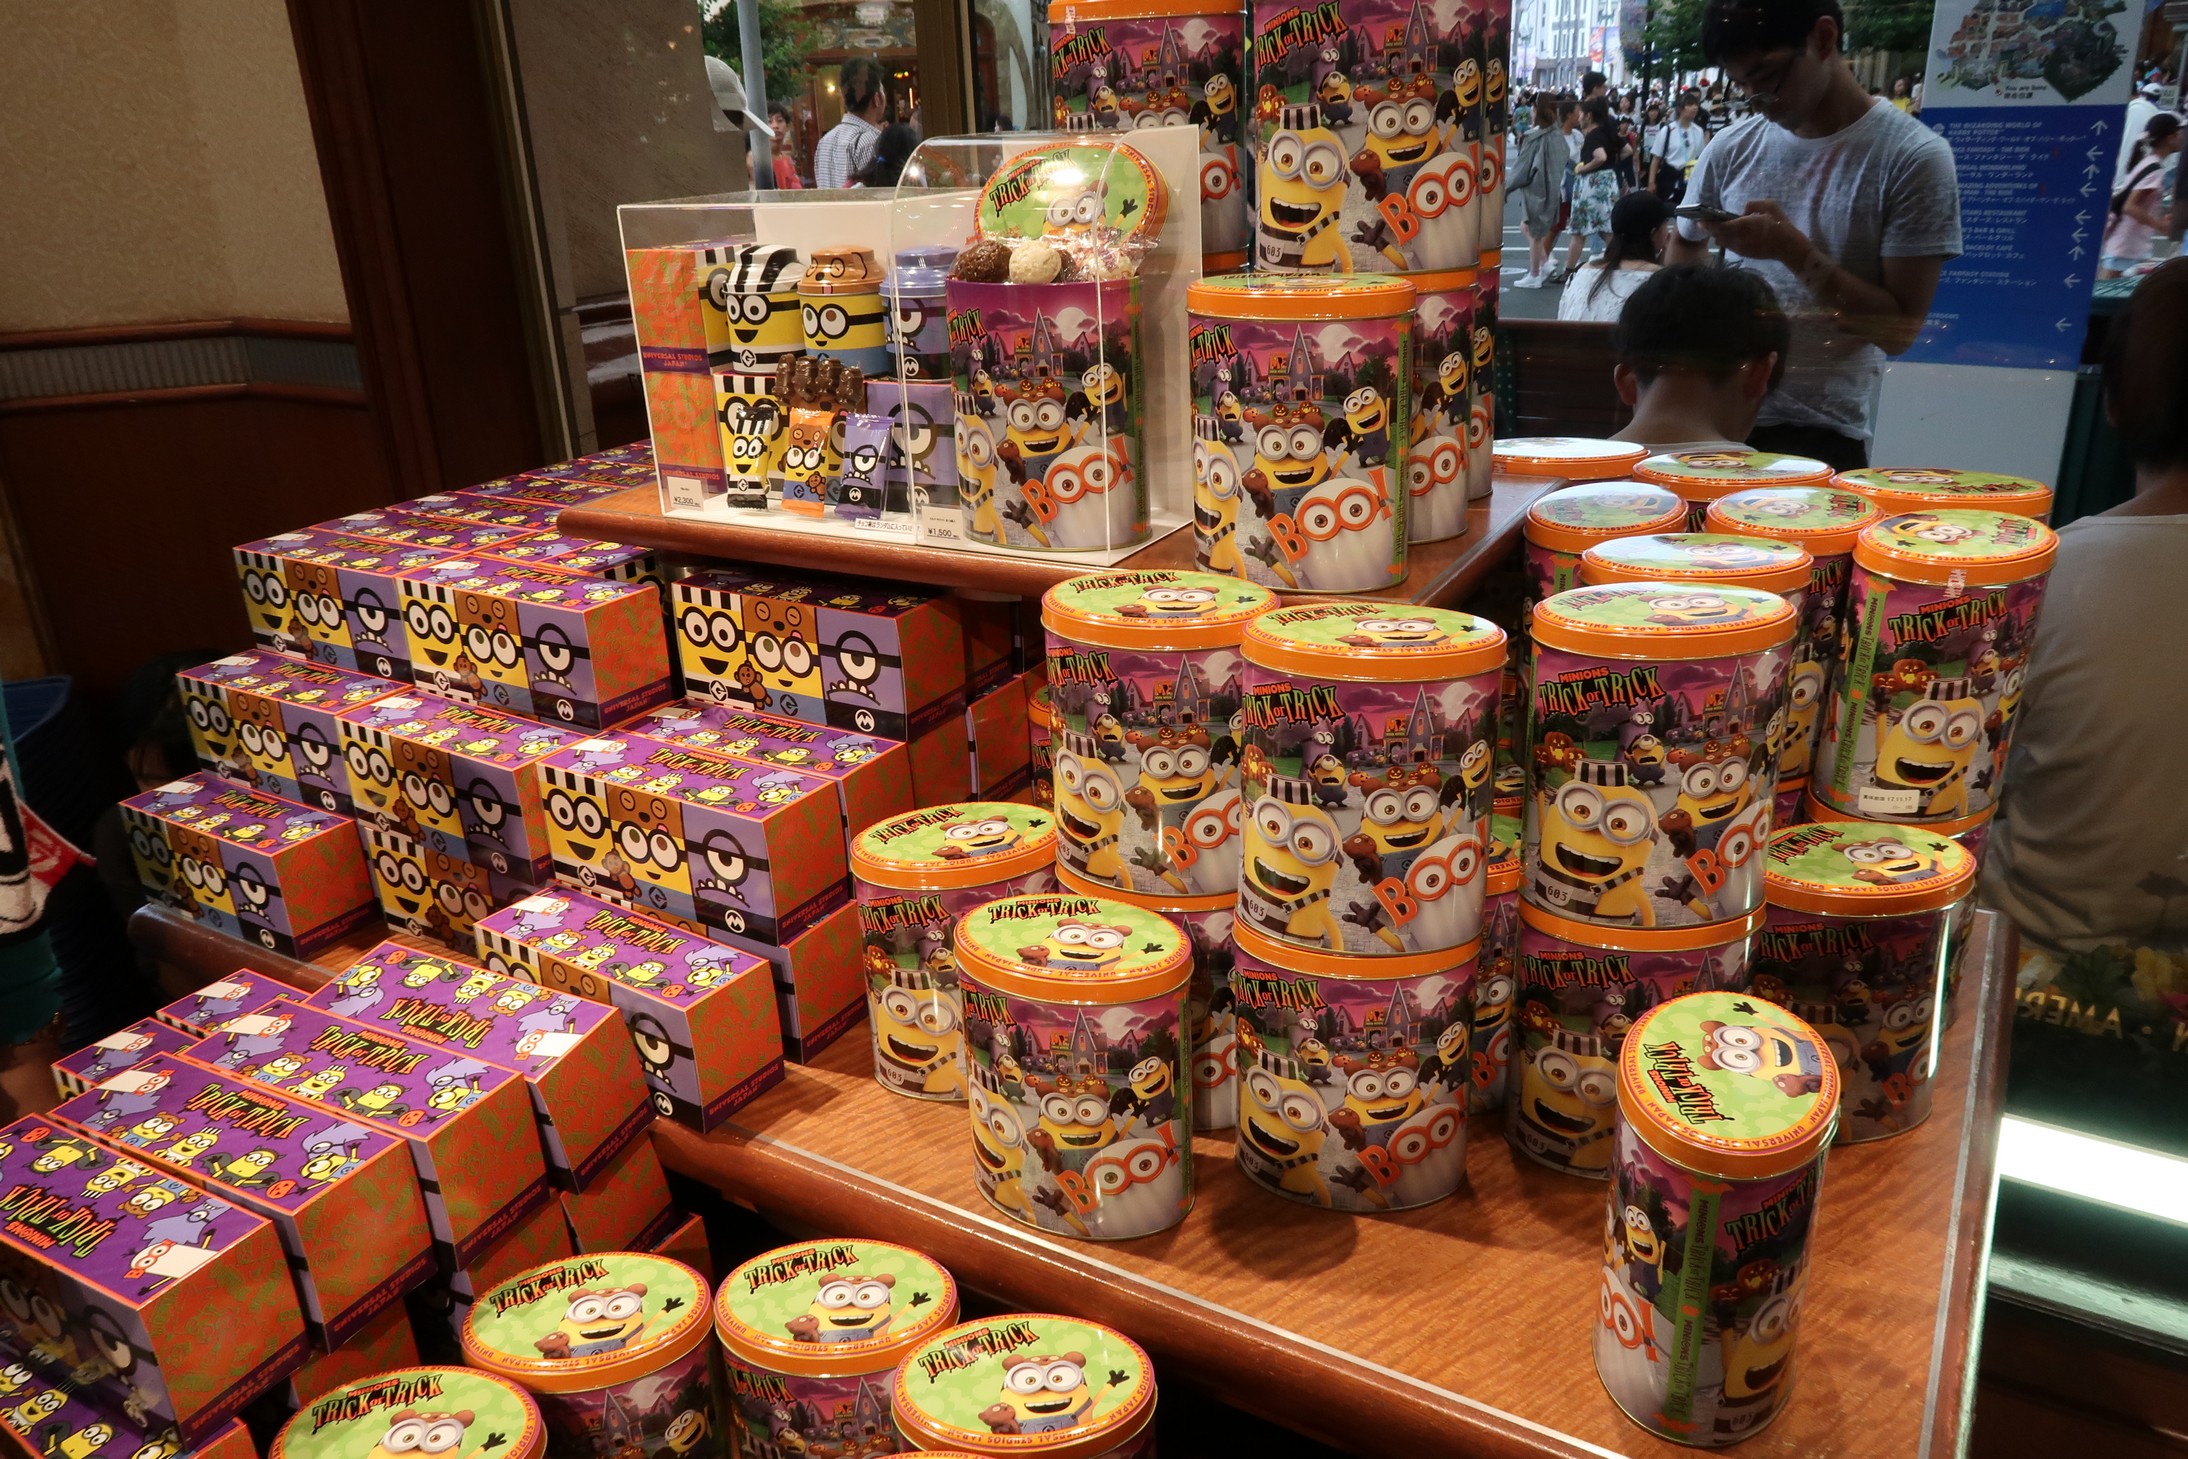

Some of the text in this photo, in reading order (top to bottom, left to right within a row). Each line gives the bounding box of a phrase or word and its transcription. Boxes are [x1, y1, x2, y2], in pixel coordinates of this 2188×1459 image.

[1264, 7, 1300, 30] MINIONS
[1284, 1, 1348, 46] or TRICK
[1069, 27, 1113, 67] TRICK
[990, 173, 1030, 213] TRICK
[1265, 243, 1282, 259] 603
[954, 308, 987, 345] TRICK
[1198, 324, 1238, 362] TRICK
[643, 352, 703, 361] UNIVERSAL STUDIOS
[928, 528, 951, 537] ¥1,500
[1070, 572, 1181, 593] TRICK TRICK
[1270, 605, 1385, 626] TRICK TRICK
[1865, 597, 1878, 636] MINIONS
[1887, 590, 2010, 645] TRICK or TRICK
[1919, 596, 1972, 614] MINIONS
[1062, 653, 1118, 689] or TRICK
[1559, 667, 1610, 682] MINIONS
[603, 694, 640, 714] UNIVERSAL
[1253, 682, 1291, 696] MINIONS
[1274, 685, 1345, 726] or TRICK
[1538, 666, 1666, 717] TRICK or TRICK
[725, 714, 824, 743] TRICK TRICK
[761, 717, 803, 729] MINIONS
[648, 747, 750, 781] TRICK TRICK
[688, 752, 732, 764] MINIONS
[870, 806, 965, 844] TRICK TRICK
[869, 896, 904, 907] MINIONS
[988, 899, 1101, 922] TRICK TRICK
[1248, 899, 1265, 919] 603
[1547, 884, 1568, 903] 603
[628, 916, 669, 932] MINIONS
[860, 894, 951, 933] TRICK or TRICK
[1774, 923, 1825, 933] MINIONS
[587, 909, 689, 955] TRICK TRICK
[1759, 923, 1876, 962] RICK or TRICK
[1522, 955, 1637, 991] TRICK or TRICK
[1539, 951, 1585, 961] MINIONS
[1243, 969, 1278, 982] MINIONS
[971, 992, 1016, 1028] TRICK
[1262, 978, 1326, 1012] or TRICK
[358, 1030, 407, 1050] MINIONS
[380, 998, 494, 1049] TRICK TRICK
[400, 1024, 448, 1045] MINIONS
[311, 1025, 431, 1075] TRICK TRICK
[1627, 1027, 1646, 1095] UNIVERSAL STUDIOS
[238, 1089, 288, 1111] MINIONS
[708, 1064, 780, 1116] UNIVERSAL STUDIOS
[1642, 1041, 1724, 1125] TRICK TRICK
[1647, 1069, 1677, 1104] MINIONS
[189, 1084, 309, 1139] TRICK TRICK
[1743, 1125, 1805, 1149] UNIVERSAL
[1, 1184, 118, 1259] TRICK TRICK
[5, 1220, 57, 1250] MINIONS
[461, 1184, 543, 1251] UNIVERSAL STUDIOS
[1726, 1199, 1789, 1249] TRICK
[744, 1245, 858, 1290] TRICK or TRICK
[771, 1249, 817, 1265] MINIONS
[489, 1258, 610, 1315] TRICK or TRICK
[519, 1265, 564, 1287] MINIONS
[333, 1258, 428, 1332] UNIVERSAL STUDIOS
[717, 1297, 746, 1335] UNIVERSAL
[919, 1321, 1040, 1378] TRICK or TRICK
[945, 1328, 989, 1348] MINIONS
[1679, 1319, 1694, 1361] MINIONS
[347, 1378, 400, 1398] MINIONS
[744, 1374, 796, 1405] TRICK
[897, 1354, 914, 1391] STUDIOS
[312, 1374, 444, 1430] TRICK or TRICK
[986, 1396, 1139, 1445] STUDIOS JAPAN
